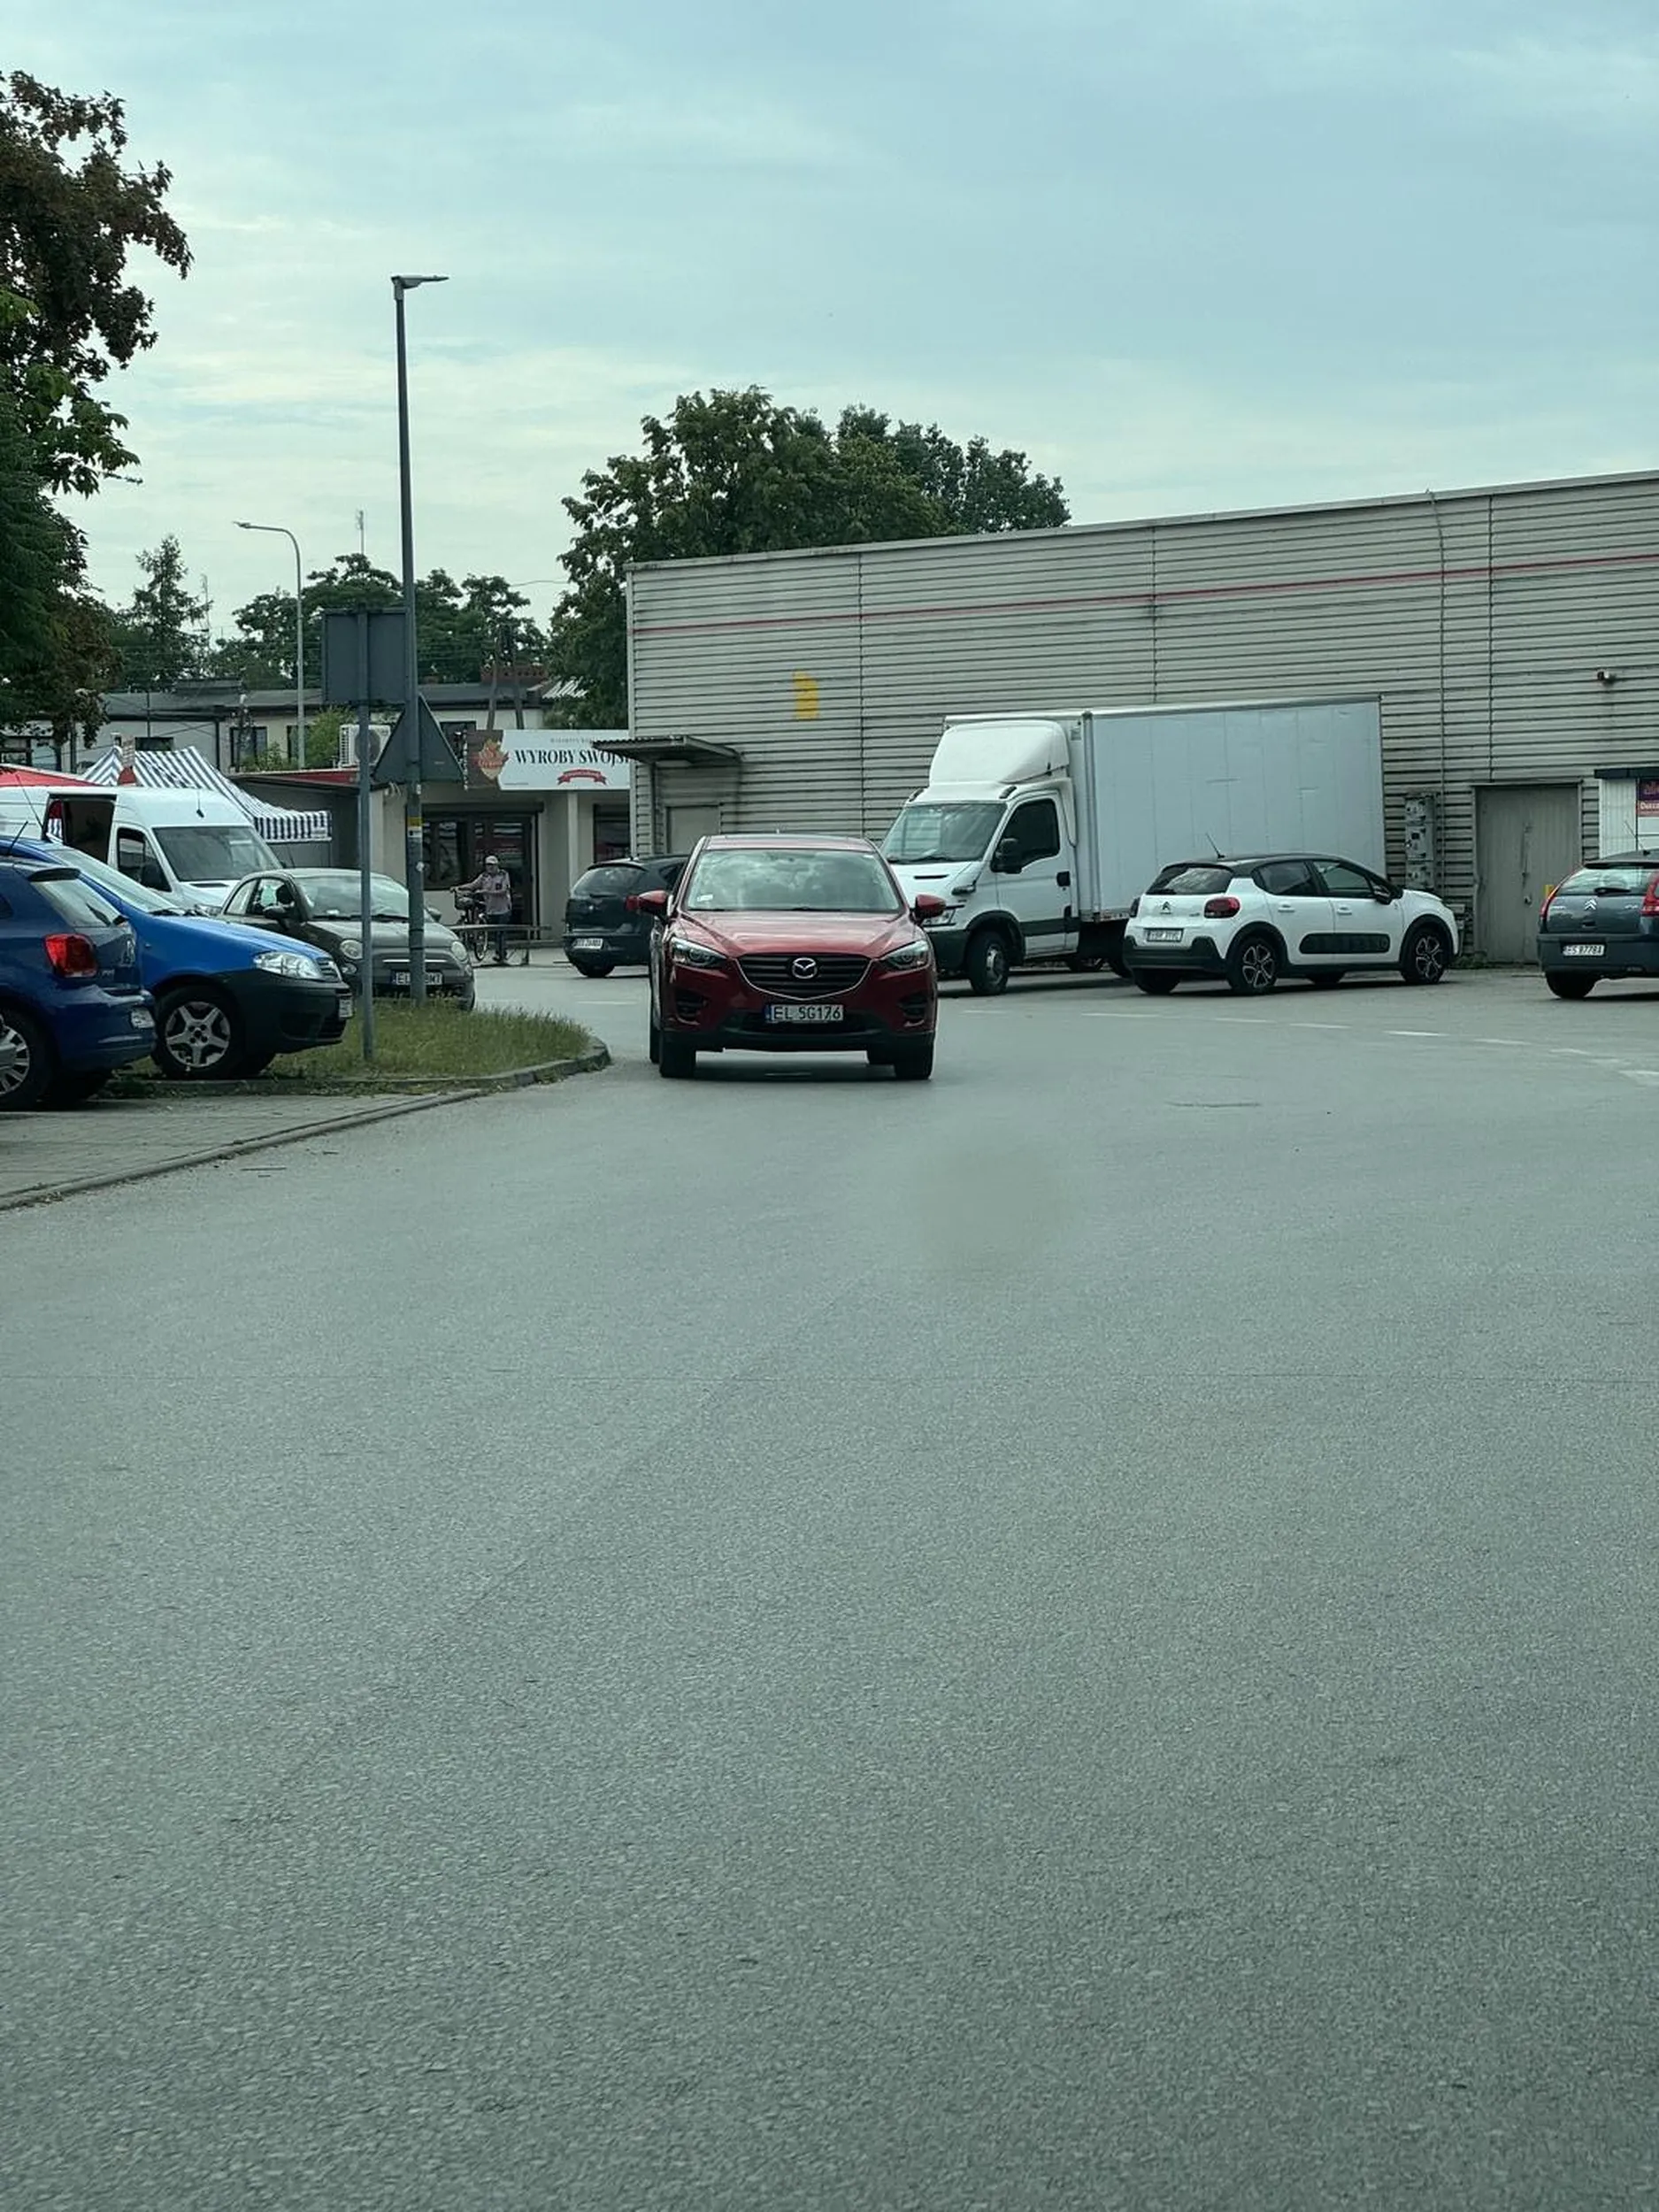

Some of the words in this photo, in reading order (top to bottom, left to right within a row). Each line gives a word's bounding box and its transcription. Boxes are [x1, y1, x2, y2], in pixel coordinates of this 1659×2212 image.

[514, 749, 575, 764] WYROBY
[579, 749, 631, 767] SWOJS
[773, 1005, 793, 1020] EL
